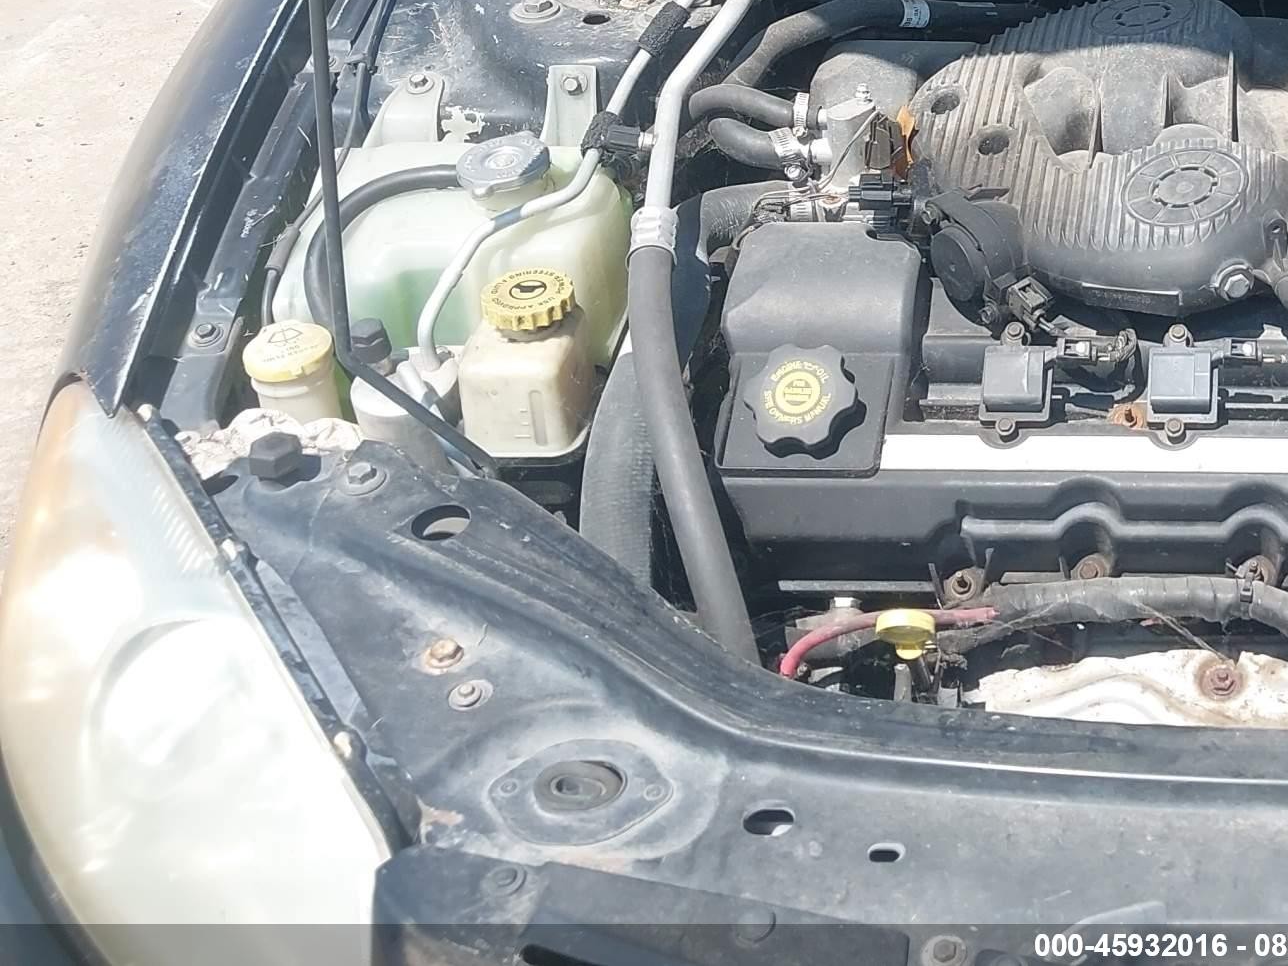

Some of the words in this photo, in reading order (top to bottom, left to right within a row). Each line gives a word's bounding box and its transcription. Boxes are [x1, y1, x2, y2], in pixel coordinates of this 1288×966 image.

[508, 269, 556, 280] STEERING
[770, 360, 802, 382] ENGINE
[816, 367, 830, 384] OIL
[804, 392, 832, 422] MANUAL
